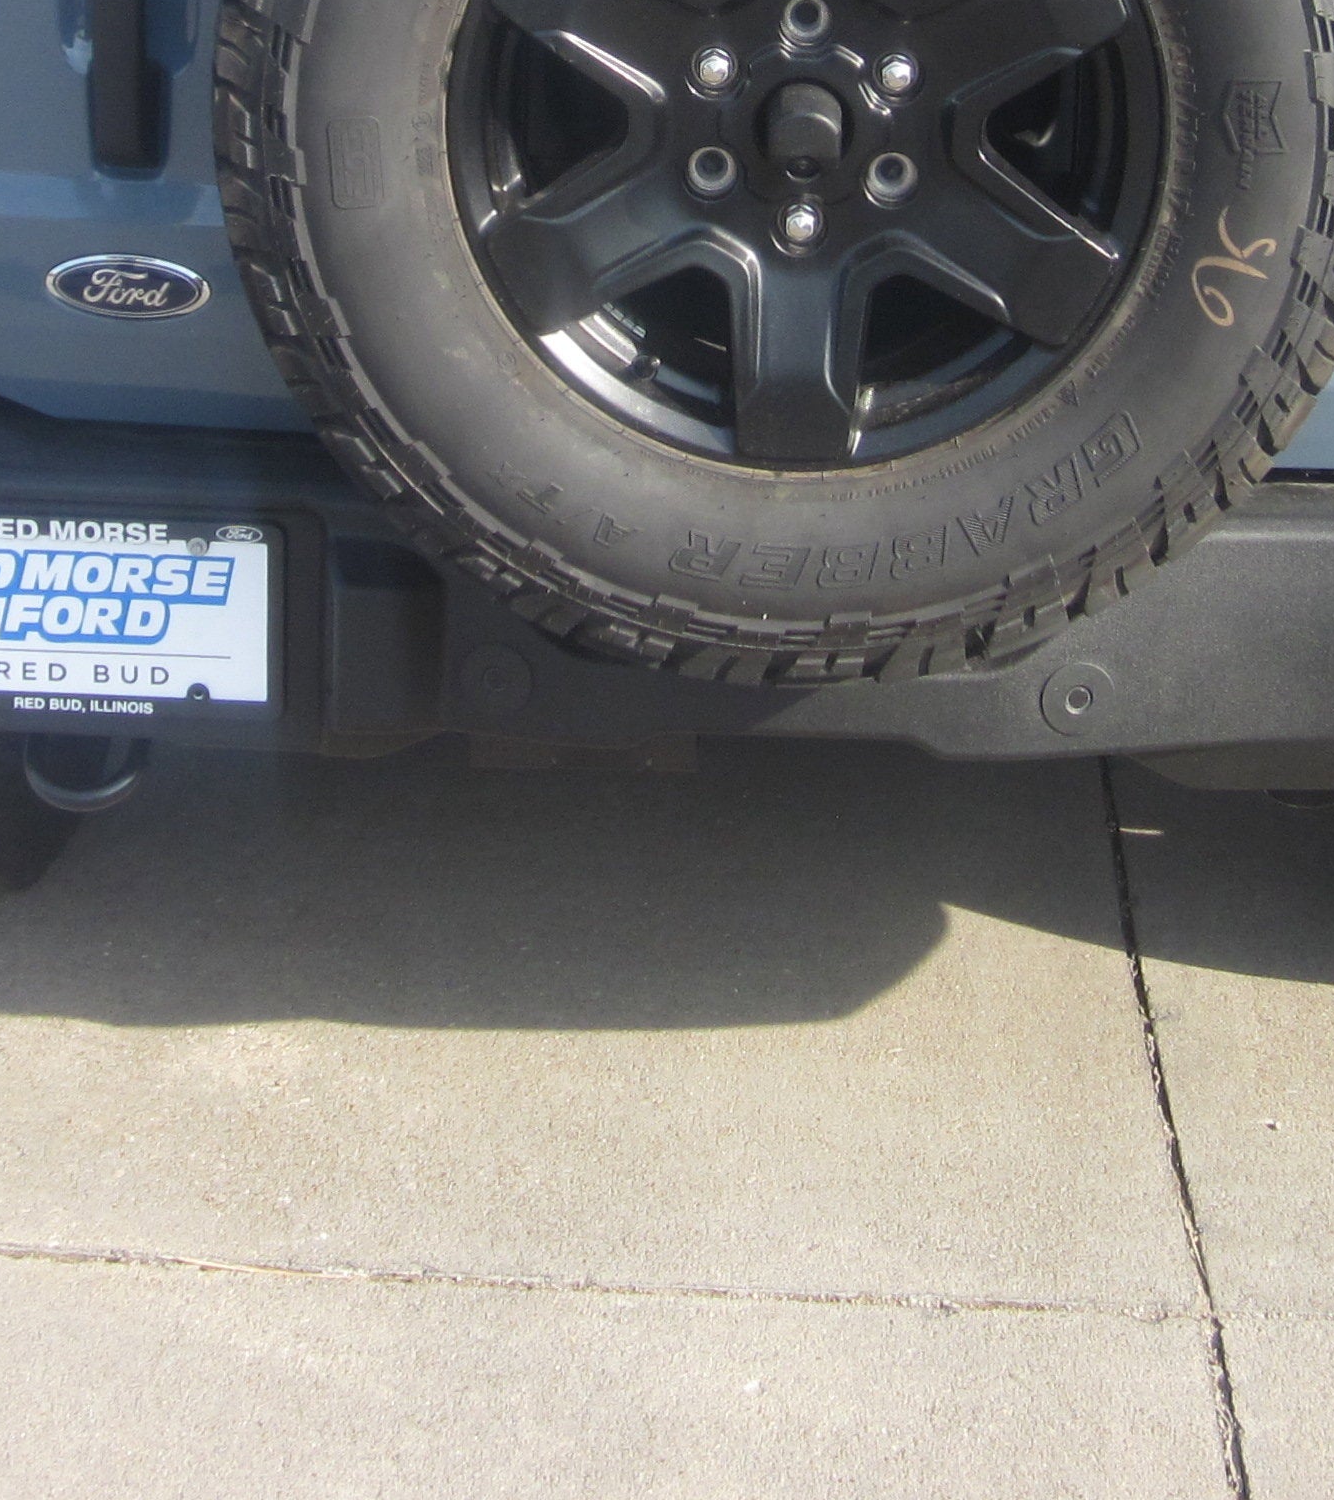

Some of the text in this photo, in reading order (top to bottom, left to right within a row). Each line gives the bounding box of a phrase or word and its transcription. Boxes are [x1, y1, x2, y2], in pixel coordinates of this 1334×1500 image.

[83, 268, 170, 307] Ford
[667, 409, 1144, 591] GRABBER
[49, 520, 169, 545] MORSE
[18, 553, 232, 598] MORSE
[4, 594, 168, 638] FORD
[93, 664, 170, 686] BUD
[13, 697, 154, 714] RED BUD, ILLINOIS
